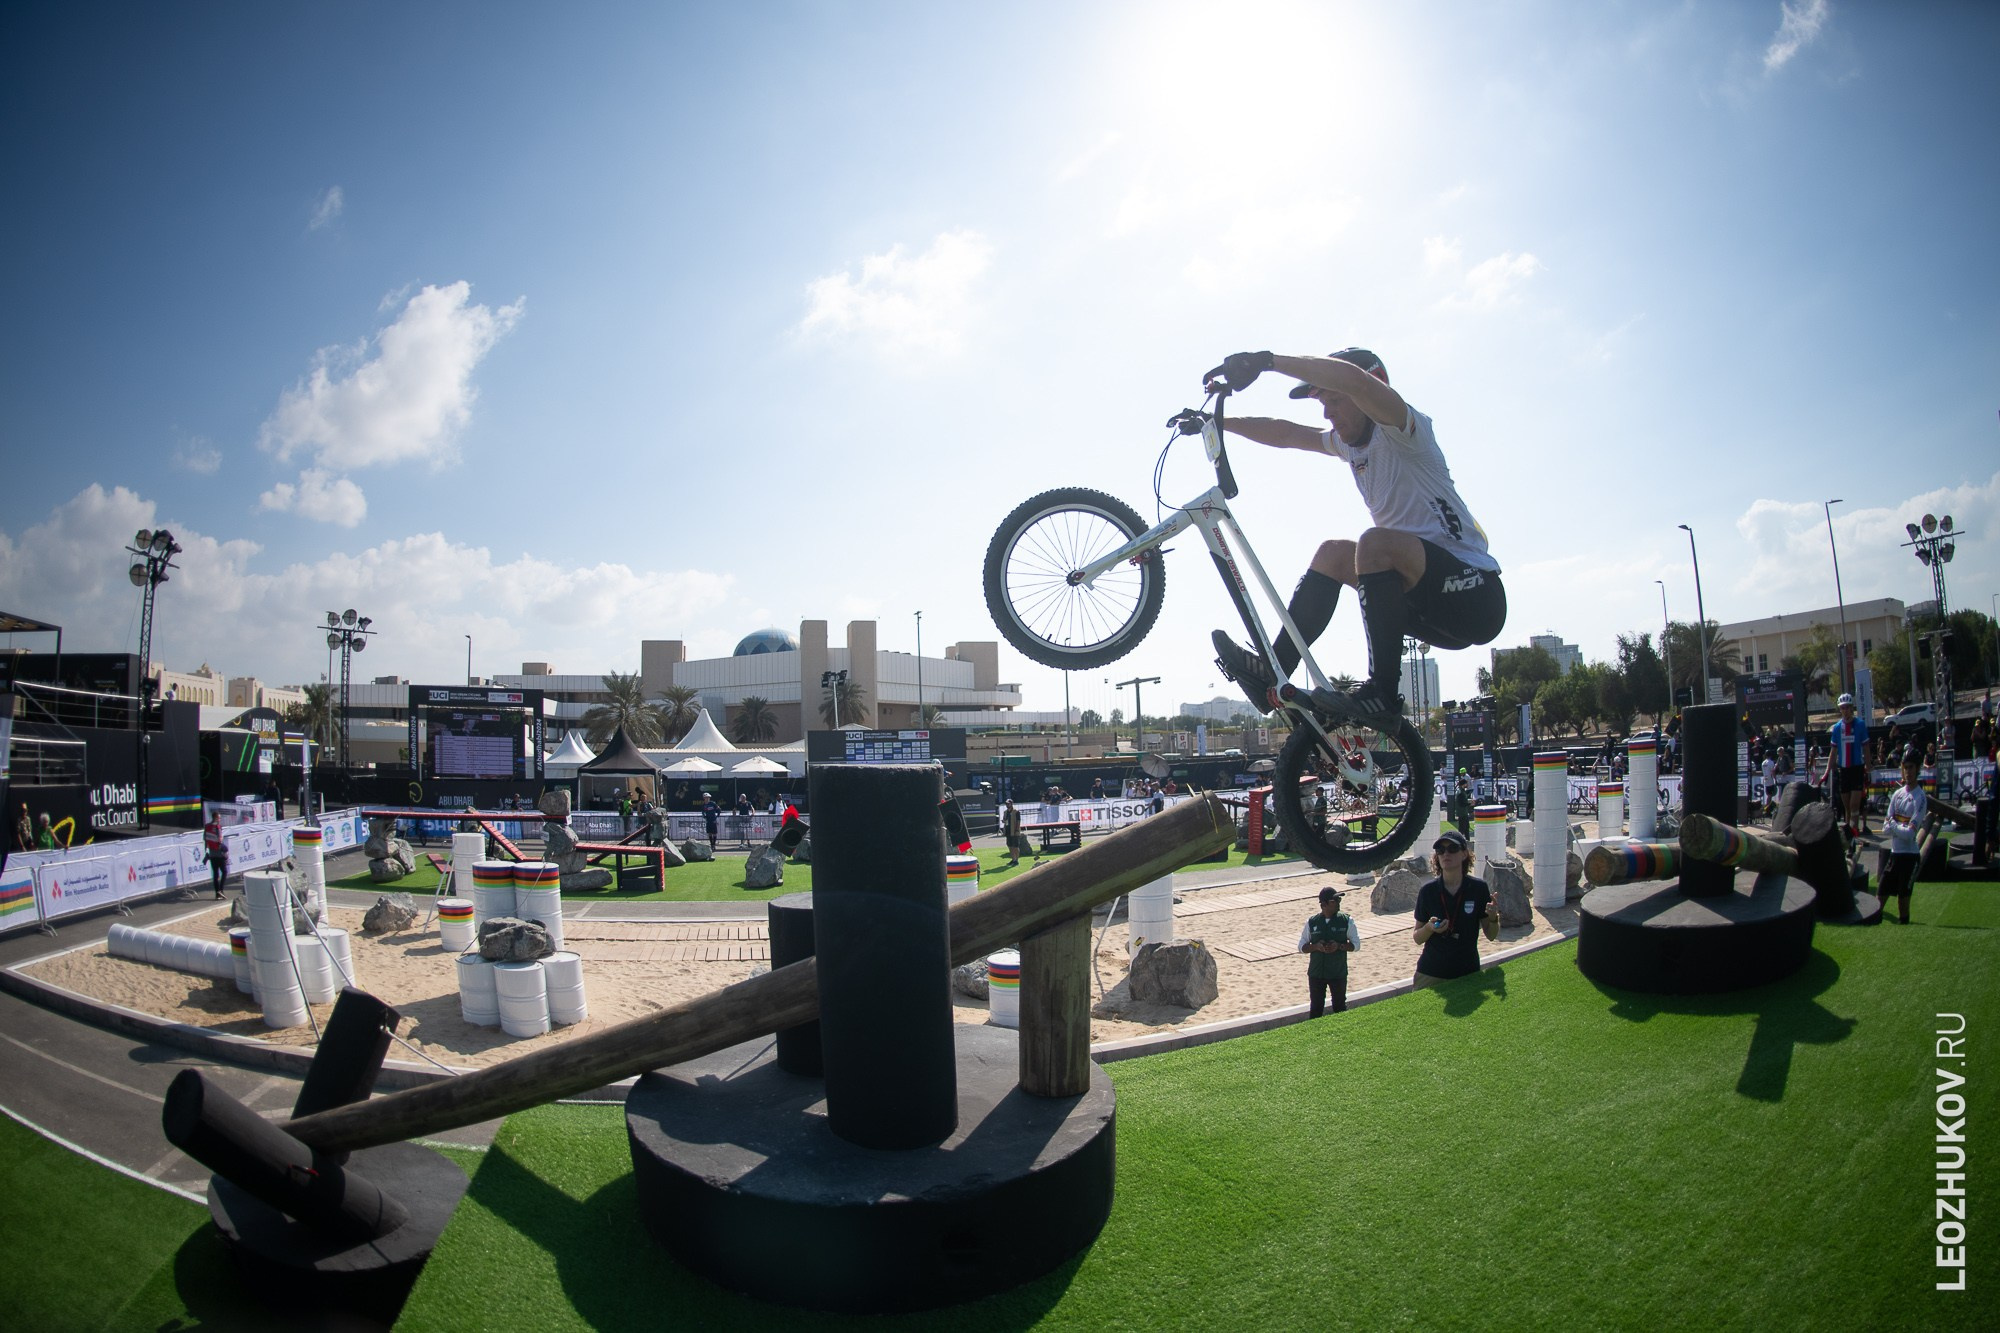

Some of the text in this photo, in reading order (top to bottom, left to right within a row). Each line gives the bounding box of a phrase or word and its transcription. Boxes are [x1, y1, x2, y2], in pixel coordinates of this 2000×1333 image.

[1213, 527, 1246, 592] DOMINIK OSWALD
[1941, 769, 1949, 783] 3
[1521, 780, 1525, 790] 1
[104, 783, 136, 805] Dhabi
[439, 796, 474, 806] ABU DHABI
[108, 808, 138, 825] Council
